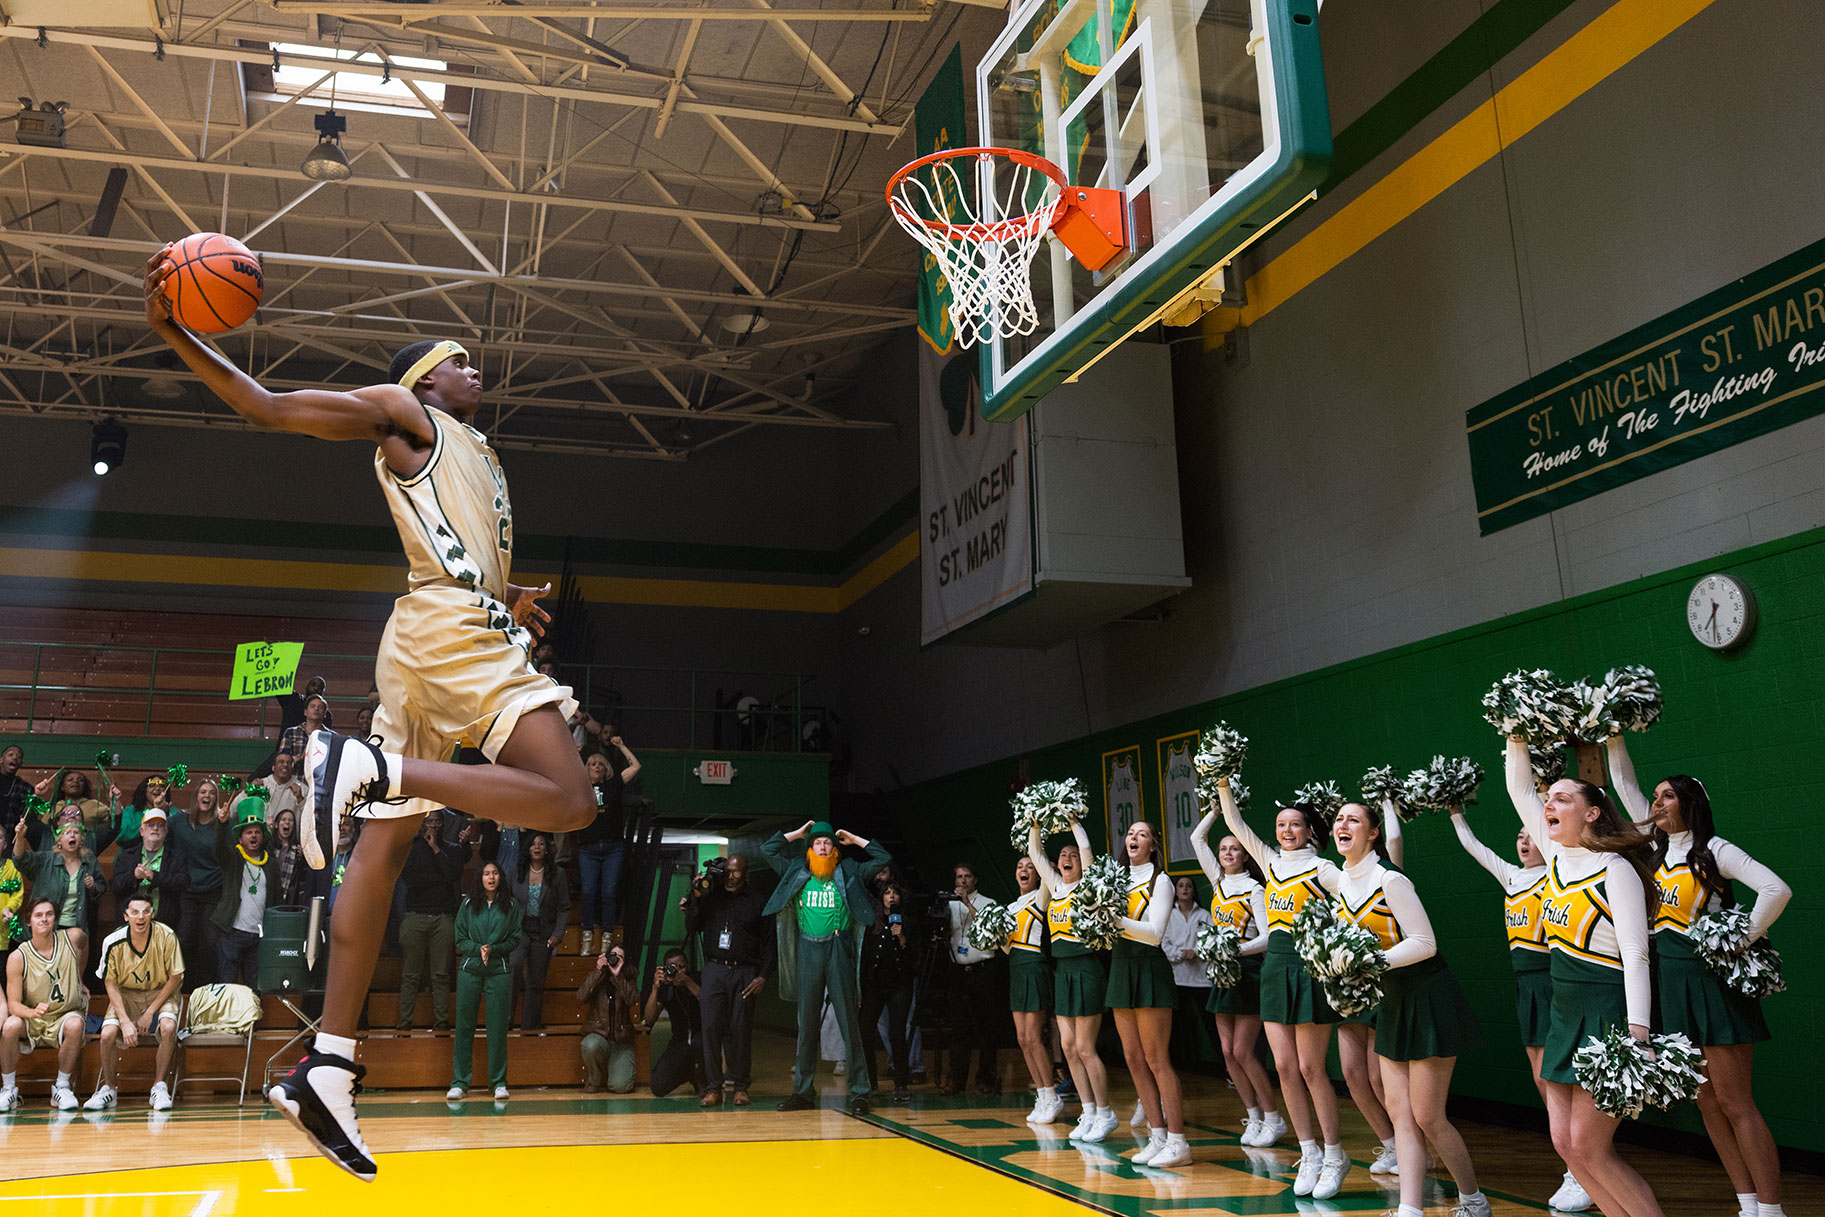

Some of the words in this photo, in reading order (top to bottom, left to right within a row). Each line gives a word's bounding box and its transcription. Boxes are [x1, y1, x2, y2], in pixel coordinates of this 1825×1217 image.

[1528, 406, 1560, 447] ST.
[1570, 349, 1681, 427] VINCENT
[1701, 325, 1742, 373] ST.
[1752, 284, 1825, 351] MAR
[1523, 445, 1582, 479] Home
[1588, 425, 1609, 457] of
[1617, 408, 1659, 440] The
[1669, 367, 1778, 425] Fighting
[929, 504, 950, 544] ST.
[954, 448, 1017, 528] VINCENT
[939, 547, 962, 587] ST.
[967, 512, 1009, 574] MARY
[246, 645, 274, 663] LETS
[241, 671, 294, 696] LEBRON
[706, 762, 728, 778] EXIT
[1174, 791, 1192, 829] 10
[806, 890, 835, 908] IRISH
[1267, 891, 1296, 912] Irish
[1213, 905, 1235, 925] Irish
[1542, 899, 1570, 927] Irish
[130, 970, 151, 983] M
[50, 983, 65, 1004] 4
